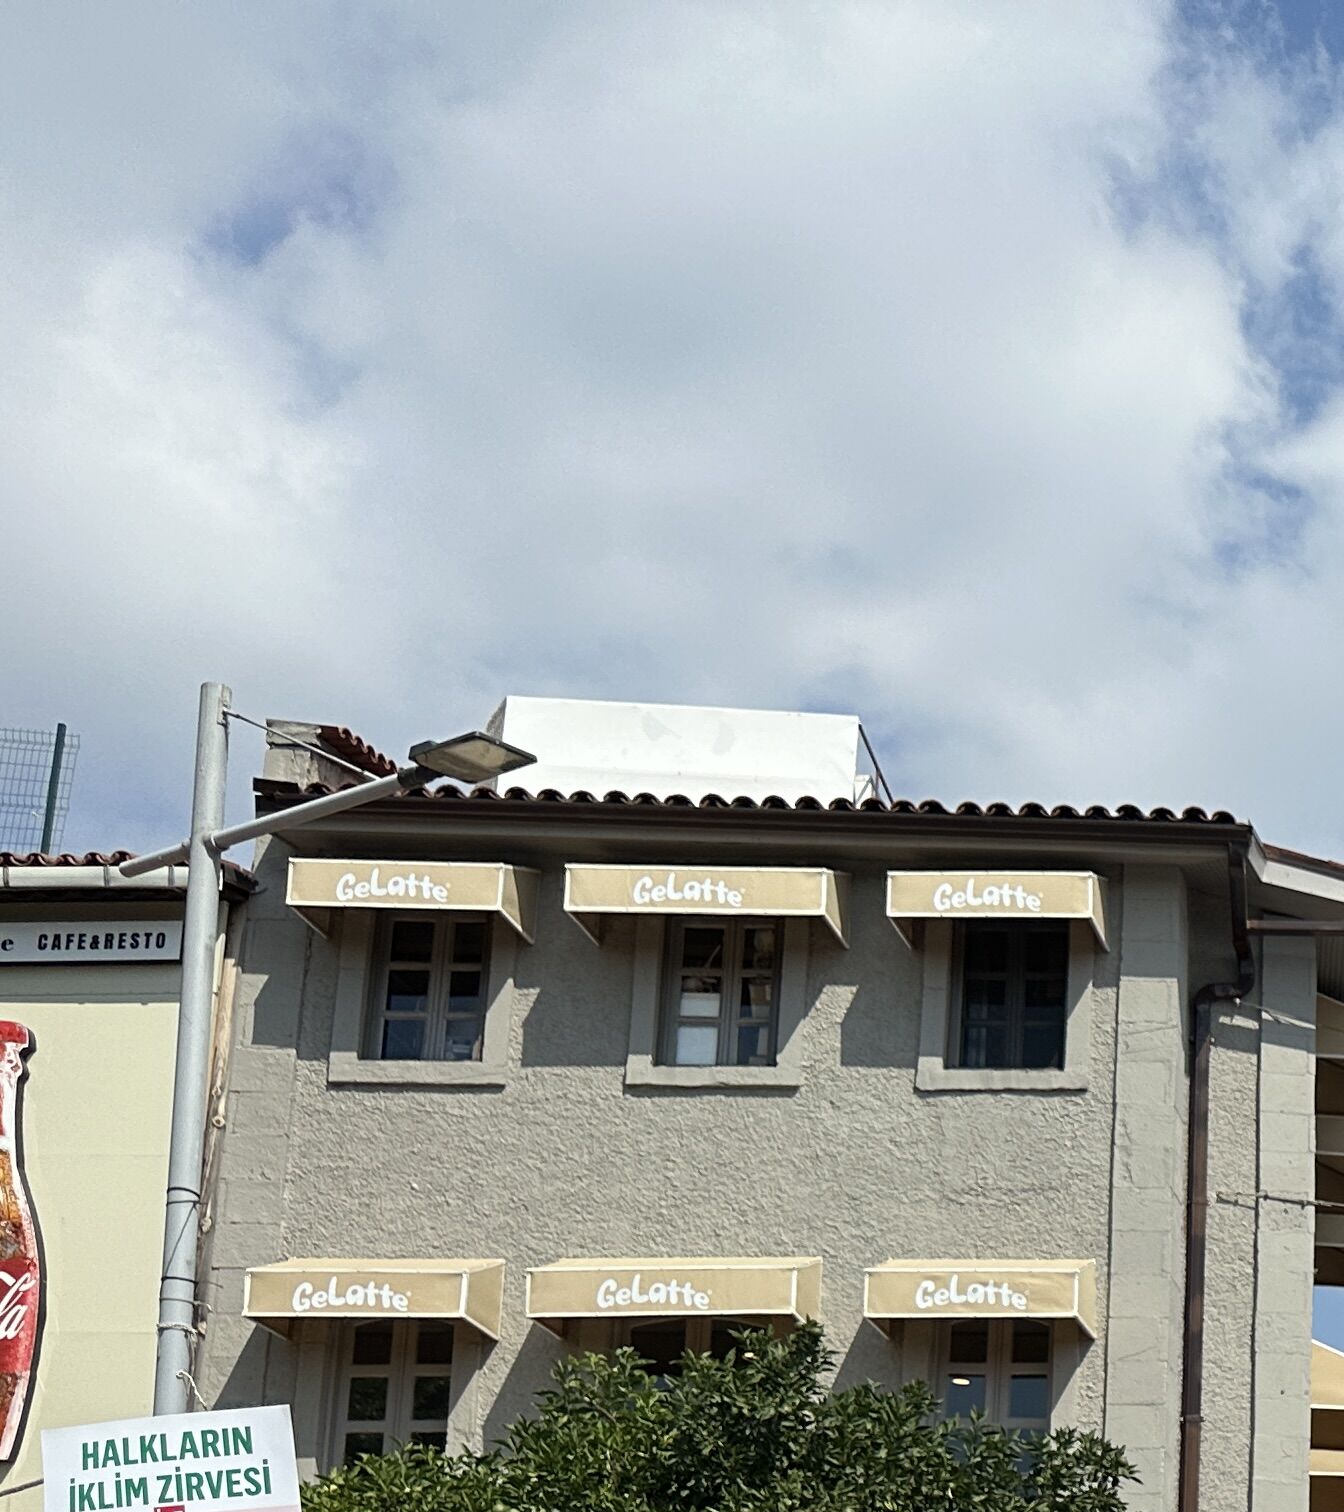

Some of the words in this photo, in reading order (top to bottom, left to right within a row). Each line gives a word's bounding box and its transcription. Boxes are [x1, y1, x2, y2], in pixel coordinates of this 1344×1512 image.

[37, 932, 166, 951] CAFE&RESTO
[82, 1426, 253, 1470] HALKLARIN
[69, 1469, 149, 1512] İKLİM
[156, 1459, 272, 1503] ZİRVESİ
